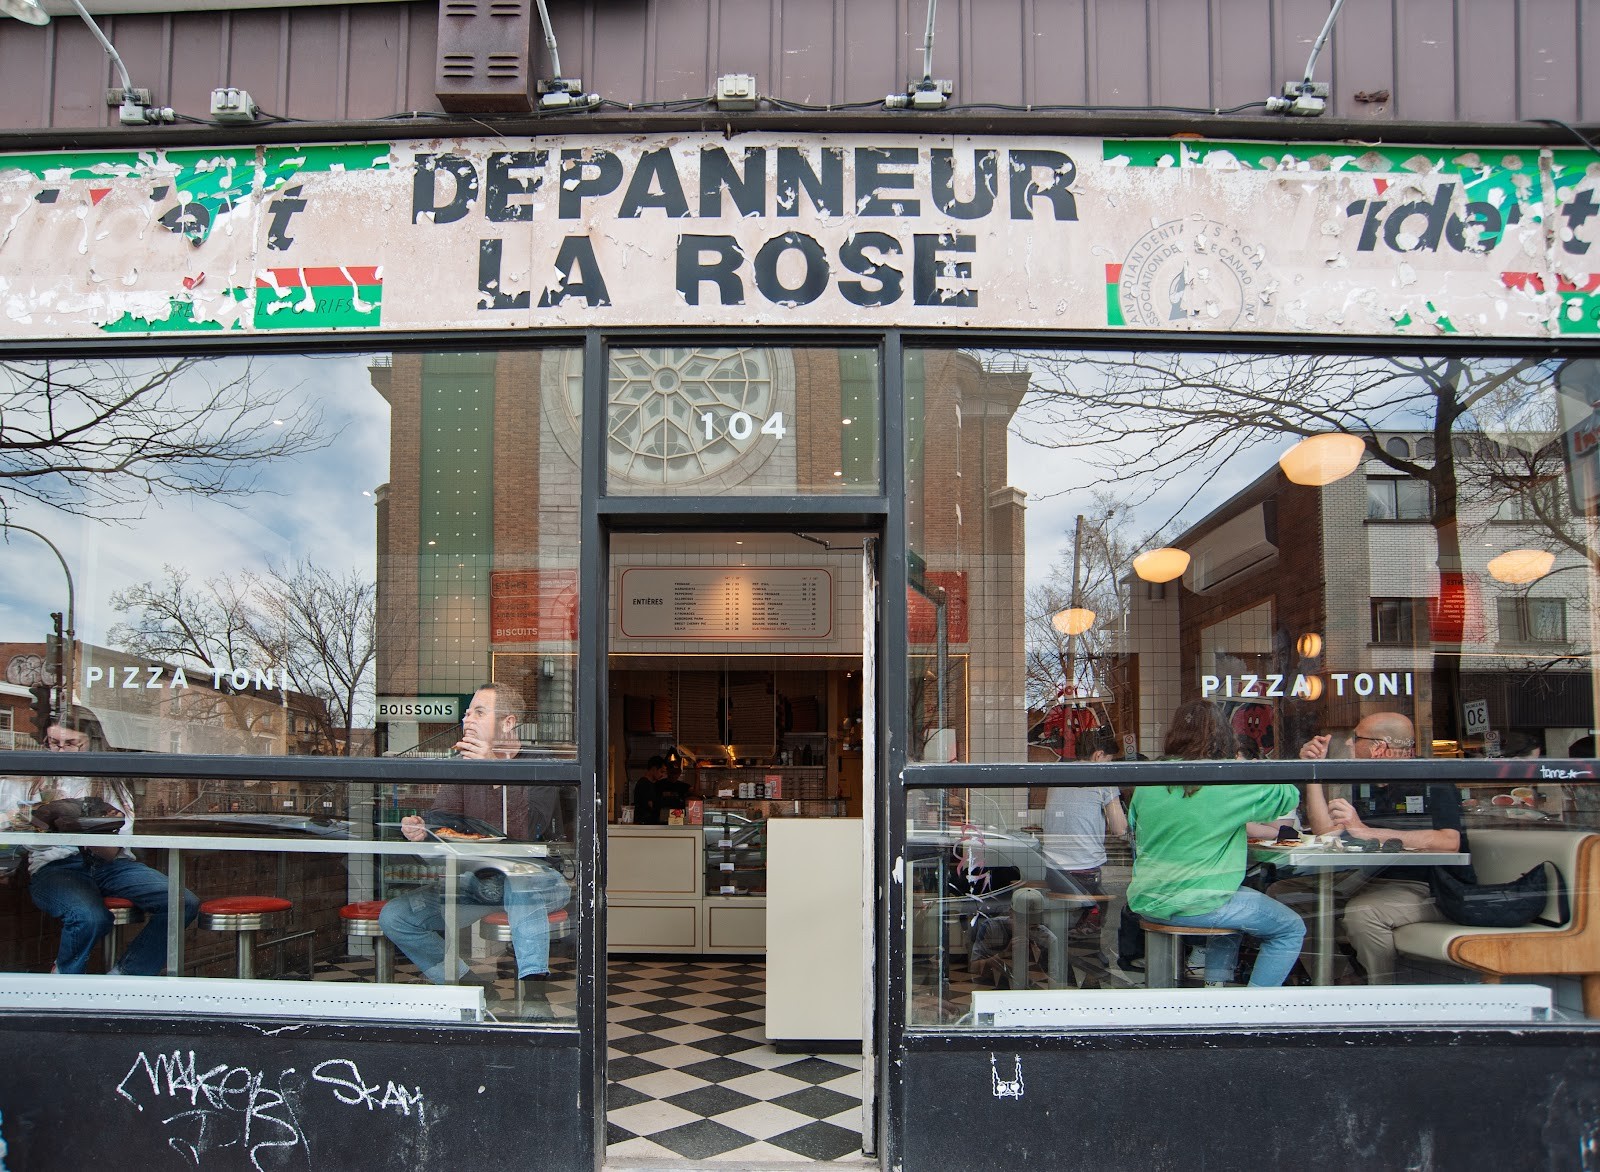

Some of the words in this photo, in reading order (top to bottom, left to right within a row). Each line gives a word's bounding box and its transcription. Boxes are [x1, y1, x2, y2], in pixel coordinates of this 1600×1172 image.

[412, 146, 1079, 225] DEPANNEUR
[477, 235, 612, 310] LA
[676, 231, 979, 308] ROSE
[701, 411, 786, 440] 104
[632, 597, 664, 606] ENTIÈRES
[496, 628, 538, 637] BISCUITS
[86, 666, 189, 689] PIZZA
[209, 667, 288, 691] TONI
[1201, 673, 1312, 698] PIZZA
[1331, 672, 1413, 696] TONI
[379, 704, 453, 716] BOISSONS
